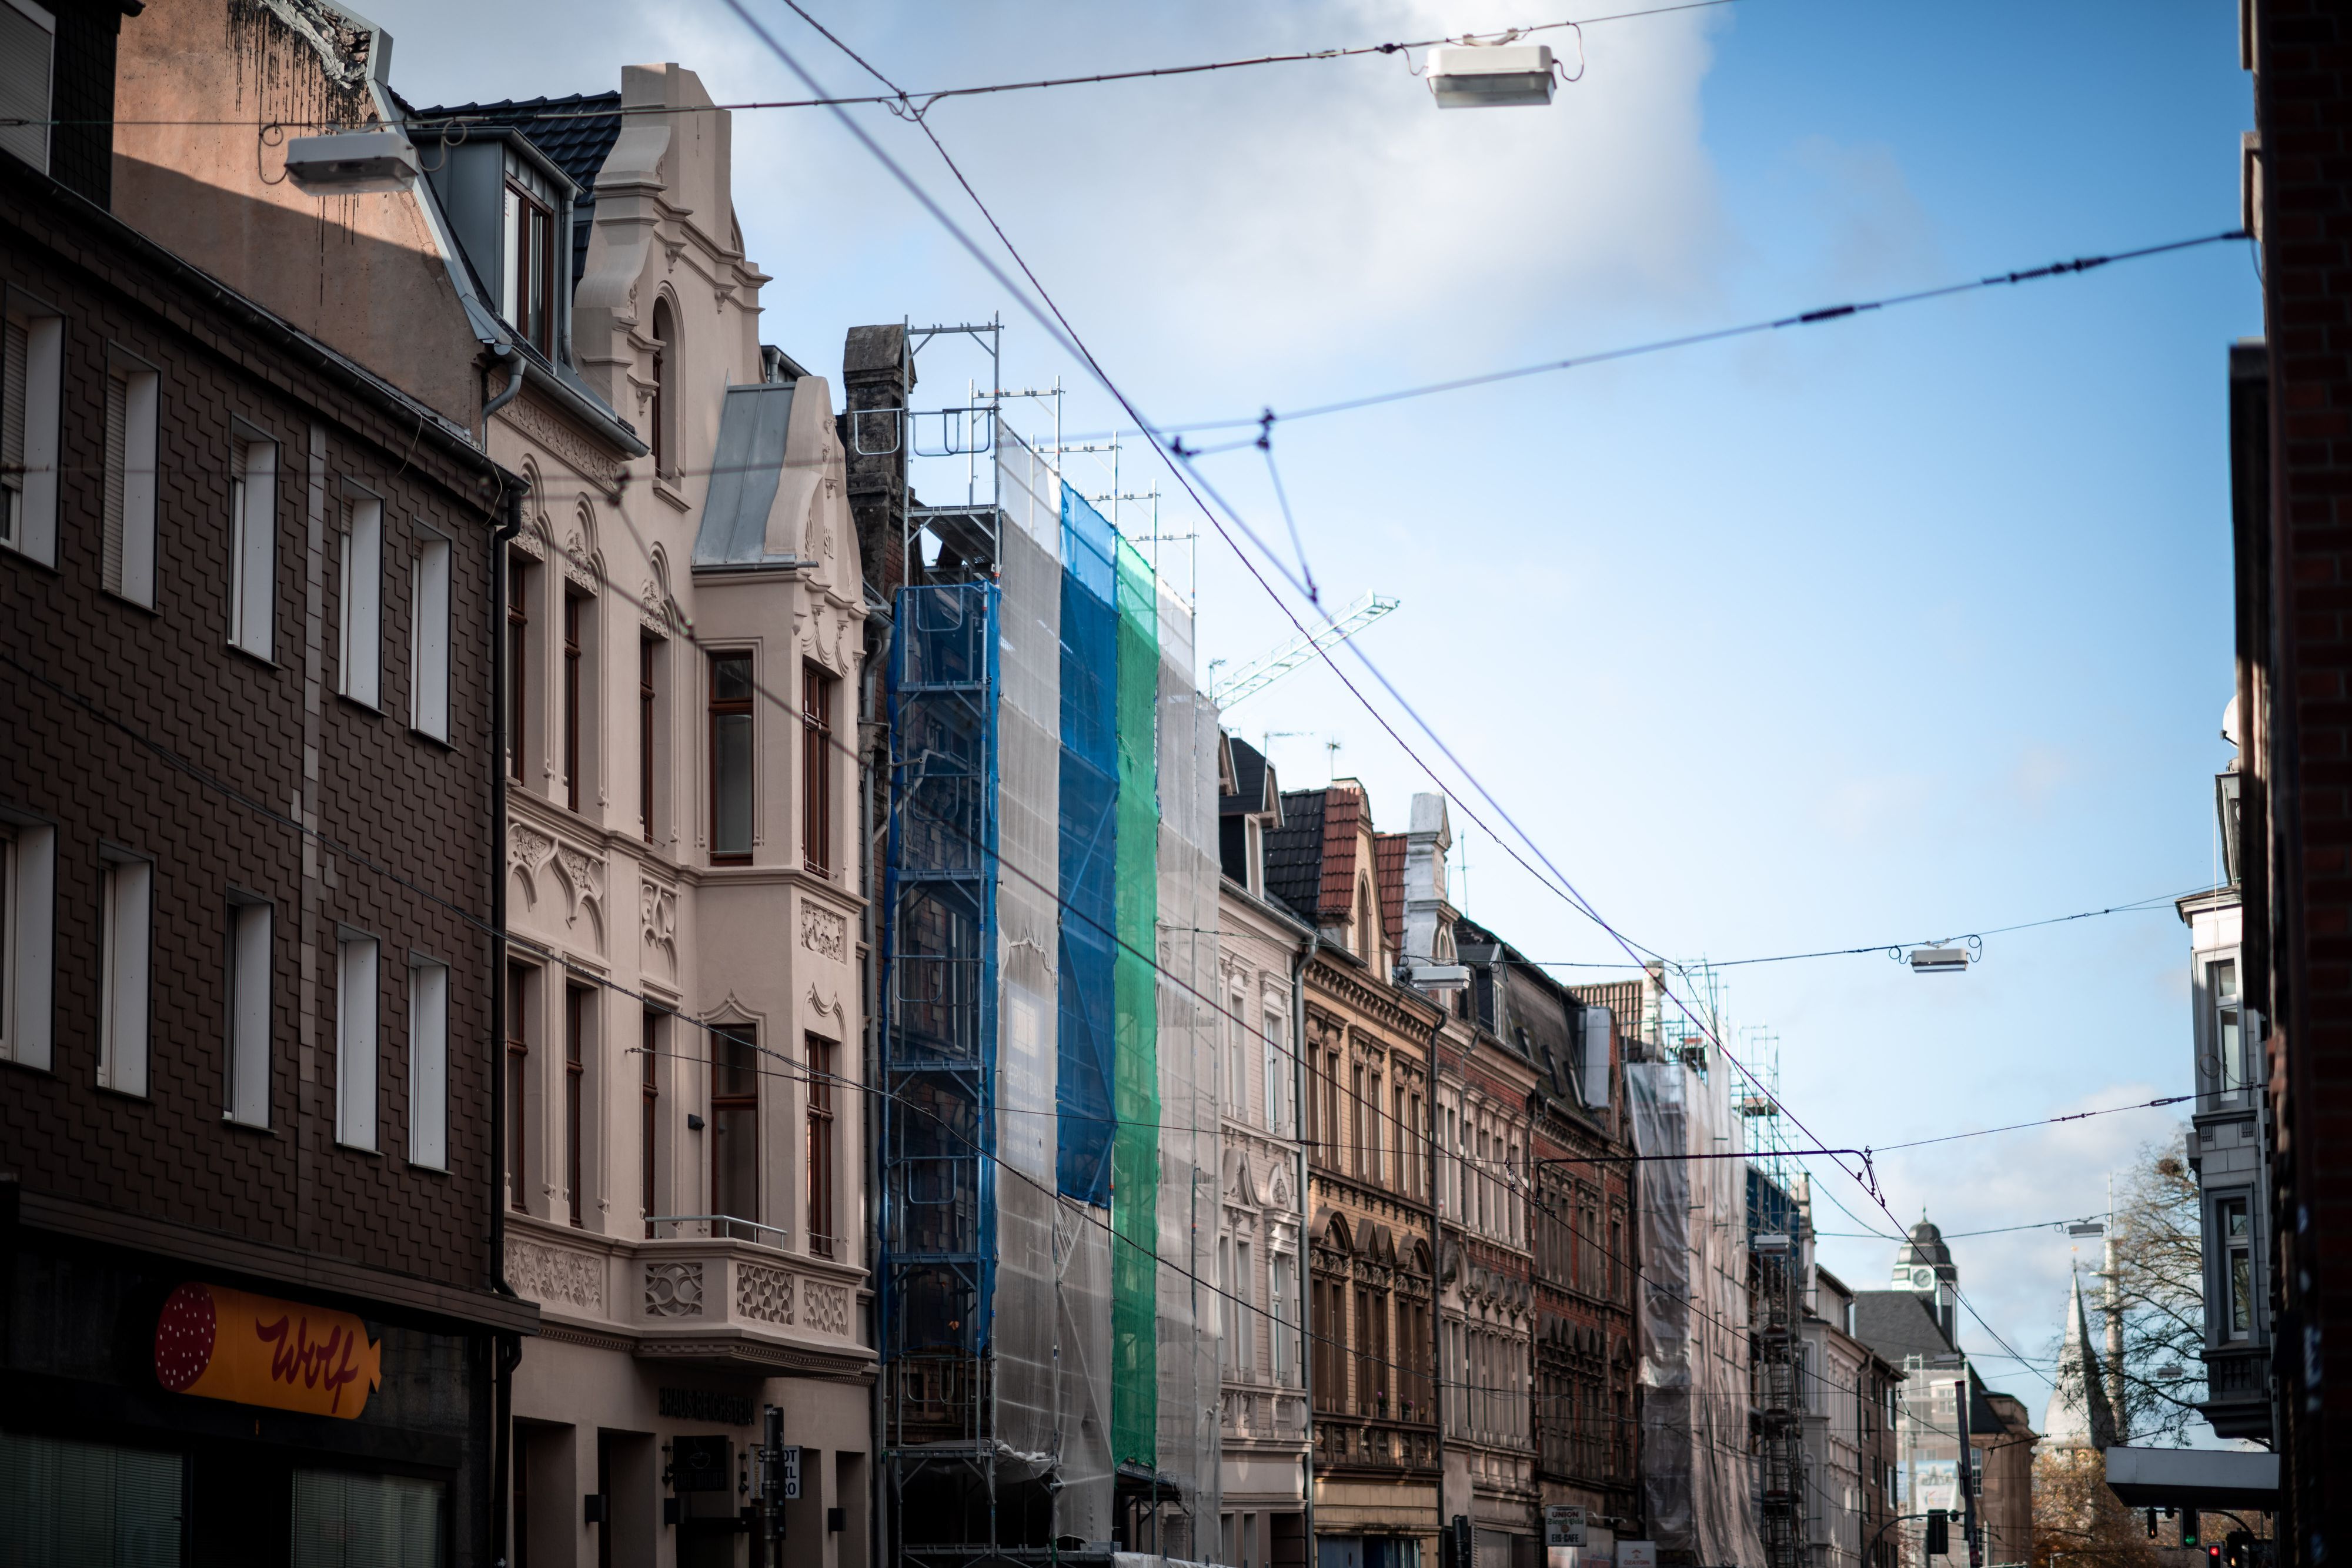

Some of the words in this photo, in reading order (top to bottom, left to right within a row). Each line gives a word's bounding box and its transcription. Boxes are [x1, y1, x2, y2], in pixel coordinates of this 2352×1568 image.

[255, 1315, 359, 1415] Wolf
[663, 1388, 696, 1418] HAUS
[1552, 1534, 1579, 1542] EIS-CAFE
